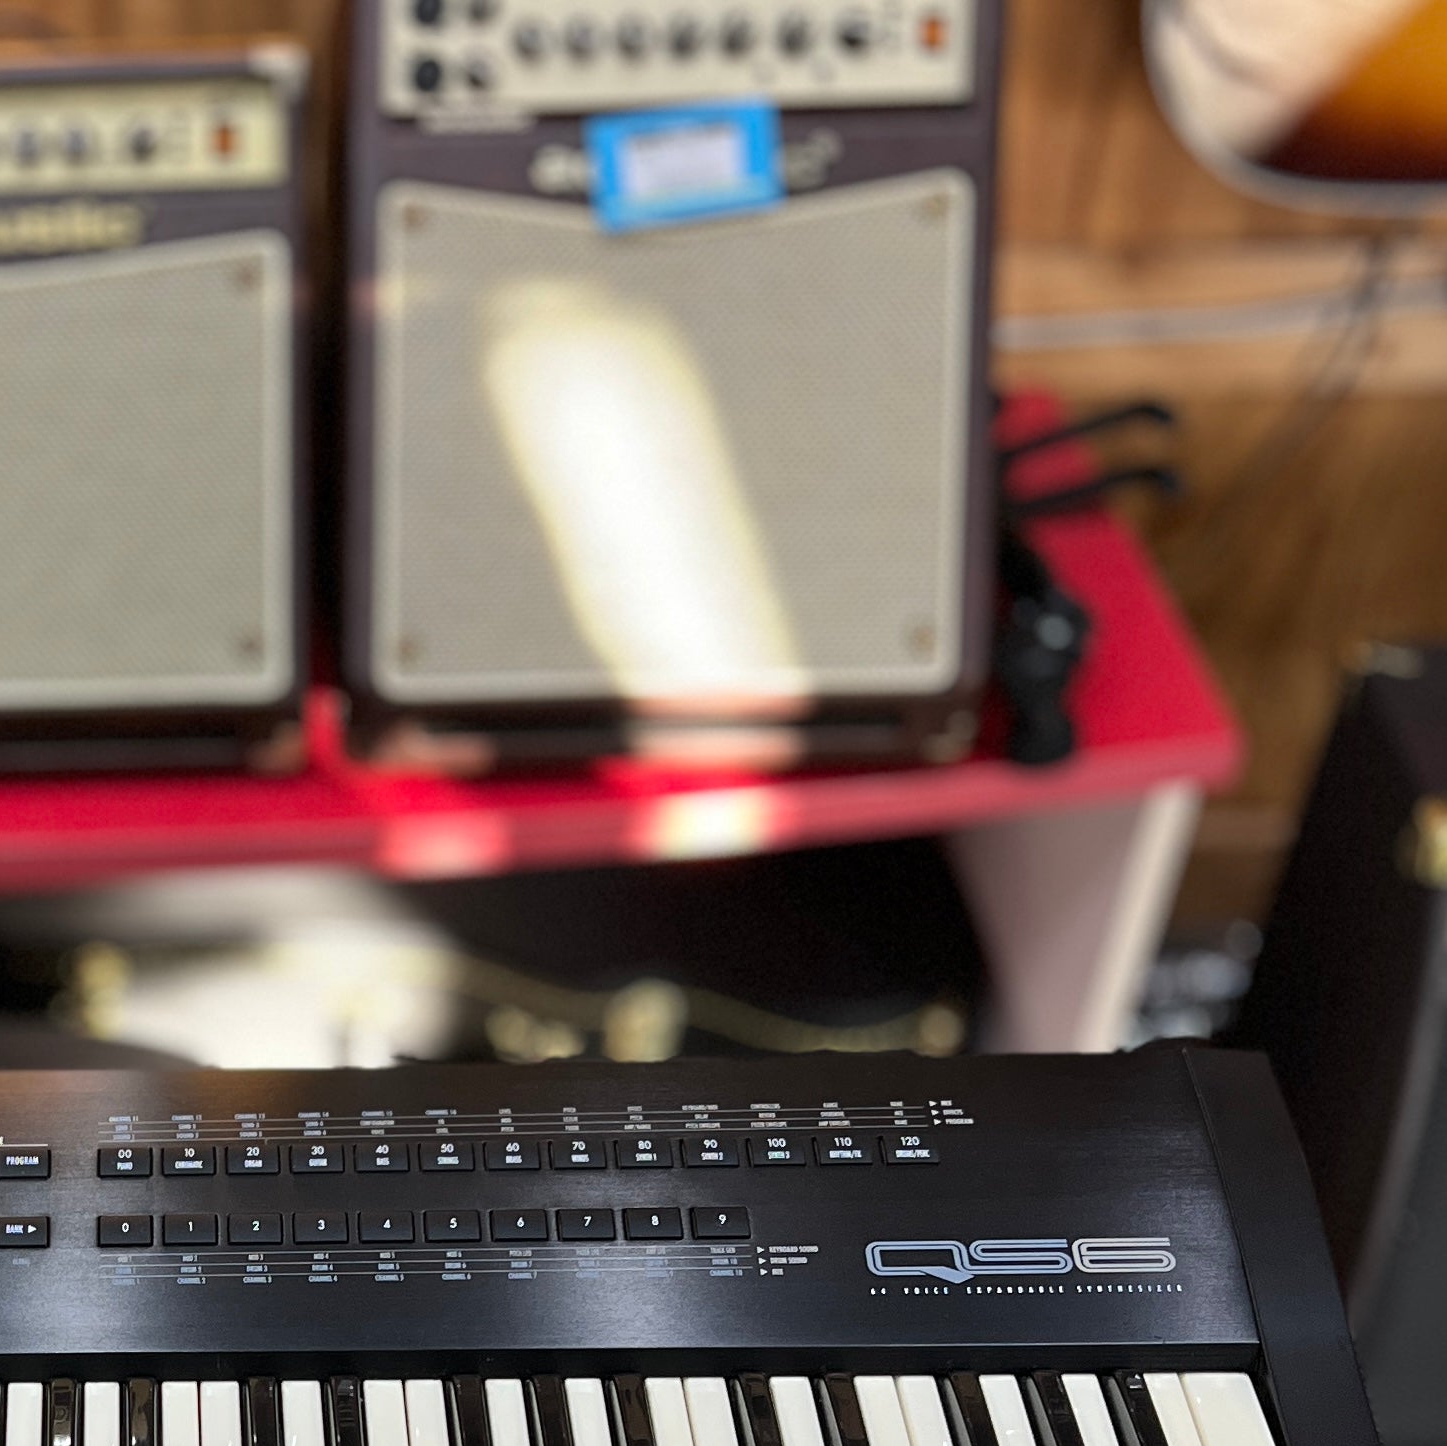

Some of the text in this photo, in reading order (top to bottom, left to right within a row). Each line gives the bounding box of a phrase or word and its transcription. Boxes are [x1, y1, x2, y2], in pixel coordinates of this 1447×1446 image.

[571, 1141, 586, 1151] 70
[703, 1139, 718, 1149] 90
[767, 1138, 786, 1148] 100
[834, 1137, 852, 1147] 110
[900, 1136, 920, 1147] 120
[184, 1148, 195, 1158] 10
[246, 1146, 260, 1157] 20
[310, 1145, 325, 1156] 30
[375, 1144, 390, 1154] 40
[440, 1143, 455, 1153] 50
[505, 1142, 520, 1153] 60
[117, 1149, 132, 1159] 00
[6, 1156, 39, 1166] PROGRAM
[317, 1219, 326, 1231] 3
[383, 1218, 391, 1229] 4
[449, 1217, 458, 1229] 5
[516, 1216, 525, 1228] 6
[583, 1216, 592, 1227] 7
[651, 1215, 660, 1226] 8
[718, 1214, 727, 1225] 9
[5, 1224, 24, 1234] BANK
[121, 1222, 130, 1233] 0
[188, 1221, 193, 1232] 1
[252, 1220, 260, 1231] 2
[865, 1236, 1177, 1285] QS6
[870, 1284, 1184, 1295] 64 VOICE EXPANDABLE SYNTHESIZER
